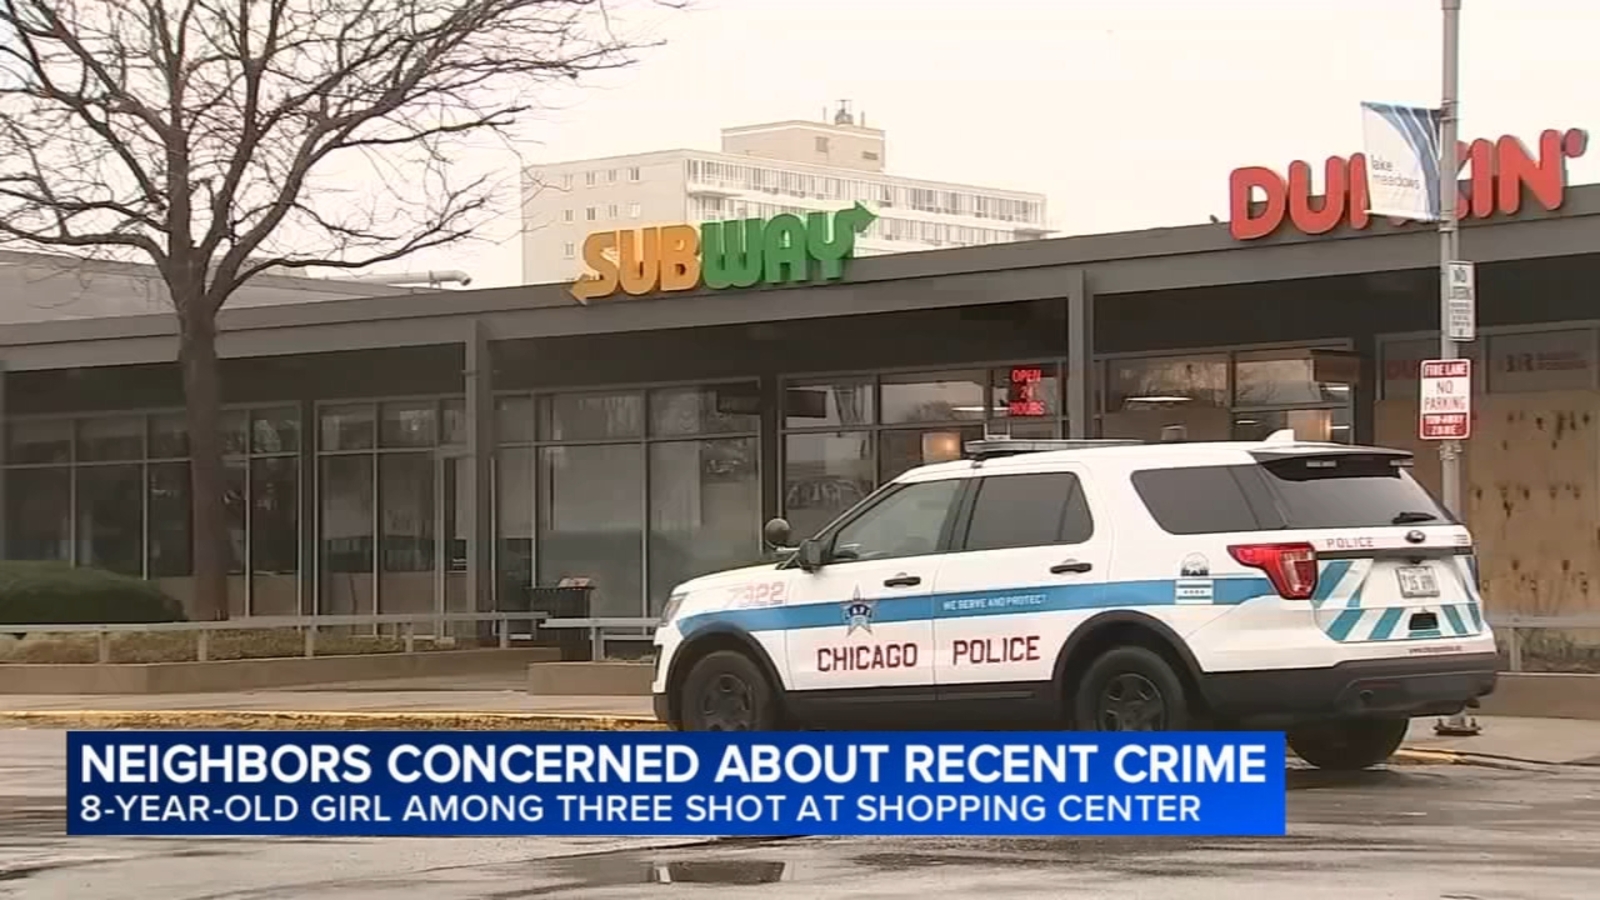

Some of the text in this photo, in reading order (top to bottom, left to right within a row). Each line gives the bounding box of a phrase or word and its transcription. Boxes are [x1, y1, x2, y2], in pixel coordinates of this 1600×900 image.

[1229, 128, 1588, 241] DUIN'
[569, 200, 878, 305] SUBWAY
[1011, 369, 1042, 383] OPEN
[1425, 364, 1445, 377] FIRE
[1446, 363, 1468, 376] LANE
[1436, 379, 1454, 394] NO
[1424, 395, 1467, 411] PARKING
[1325, 536, 1375, 549] POLICE
[958, 599, 987, 610] SERVE
[988, 597, 1005, 607] AND
[1007, 594, 1047, 606] PROTECT
[817, 635, 1041, 672] CHICAGO POLICE
